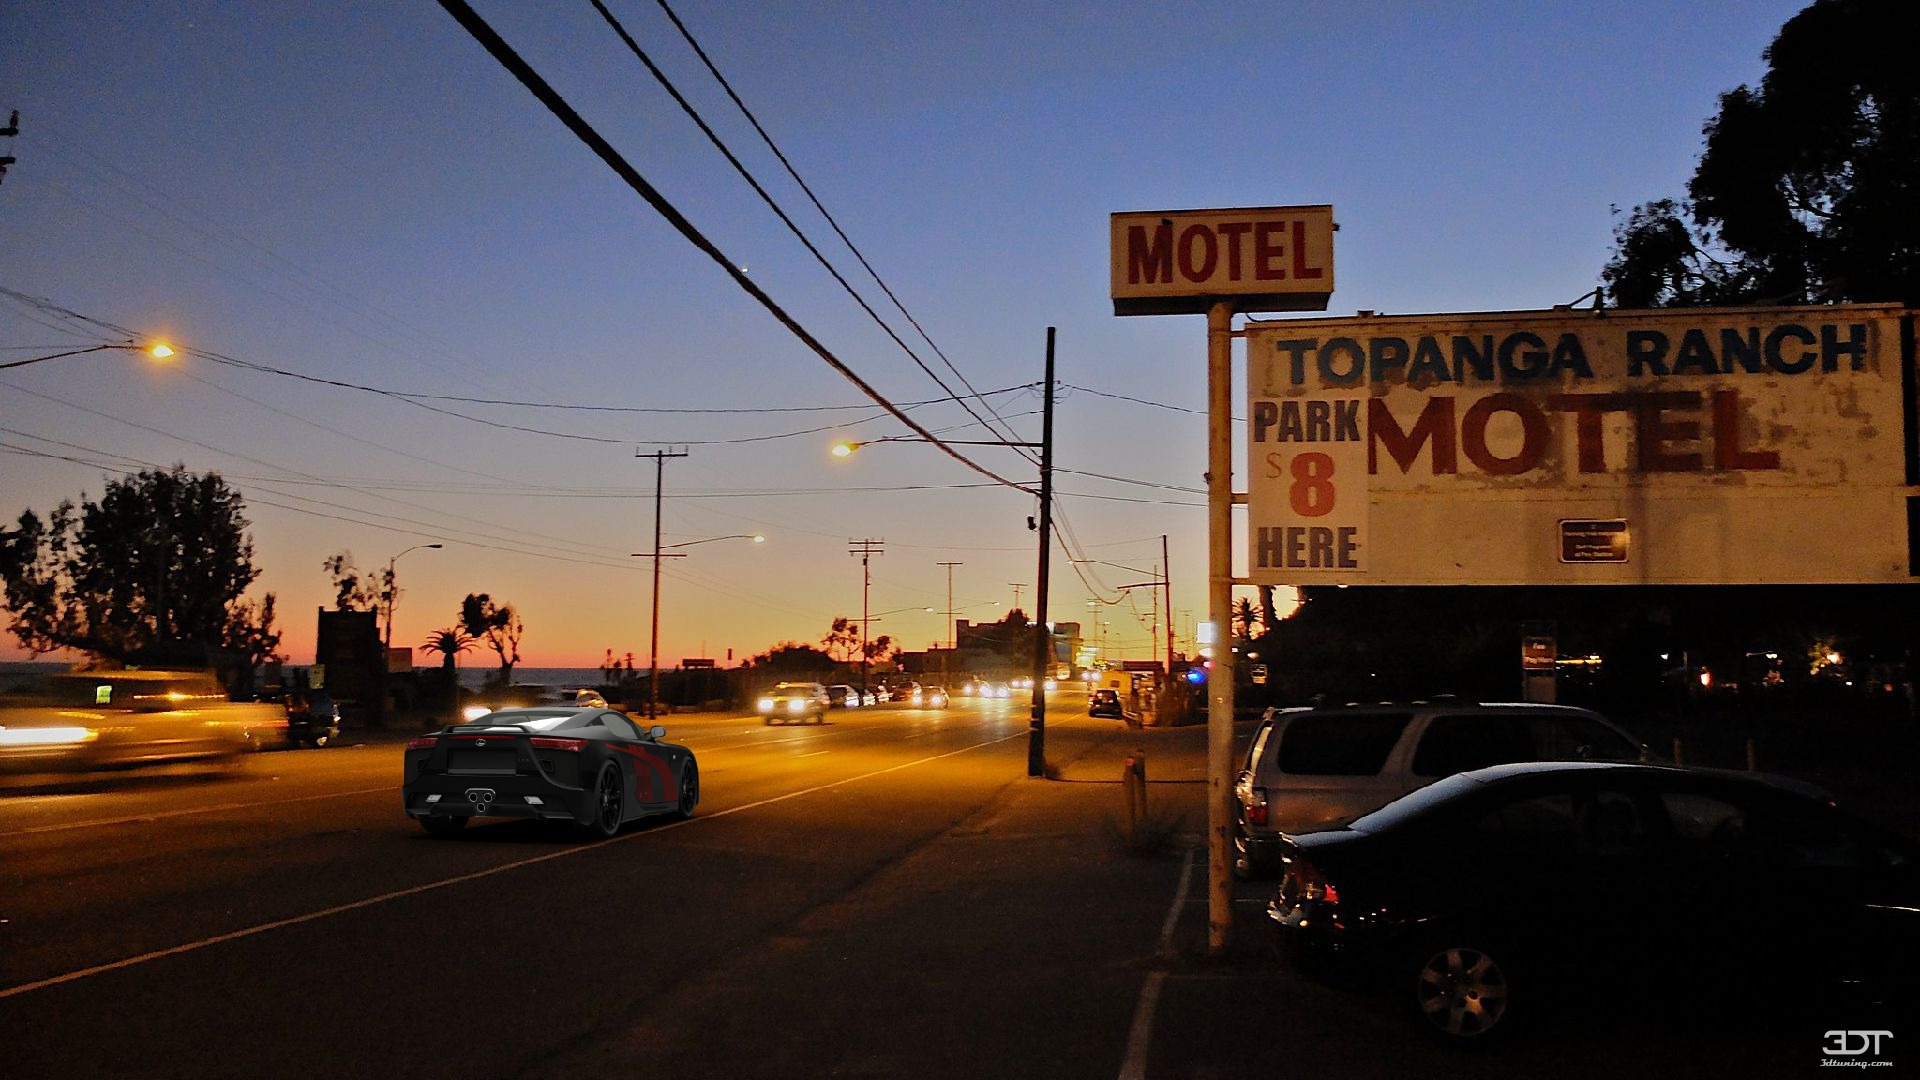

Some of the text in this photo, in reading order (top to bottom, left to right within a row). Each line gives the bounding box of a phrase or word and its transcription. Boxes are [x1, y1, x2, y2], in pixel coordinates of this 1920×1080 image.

[1127, 220, 1323, 285] MOTEL
[1277, 324, 1867, 386] TOPANGA RANCH
[1253, 399, 1361, 443] PARK
[1367, 390, 1780, 476] MOTEL
[1256, 526, 1358, 569] HERE
